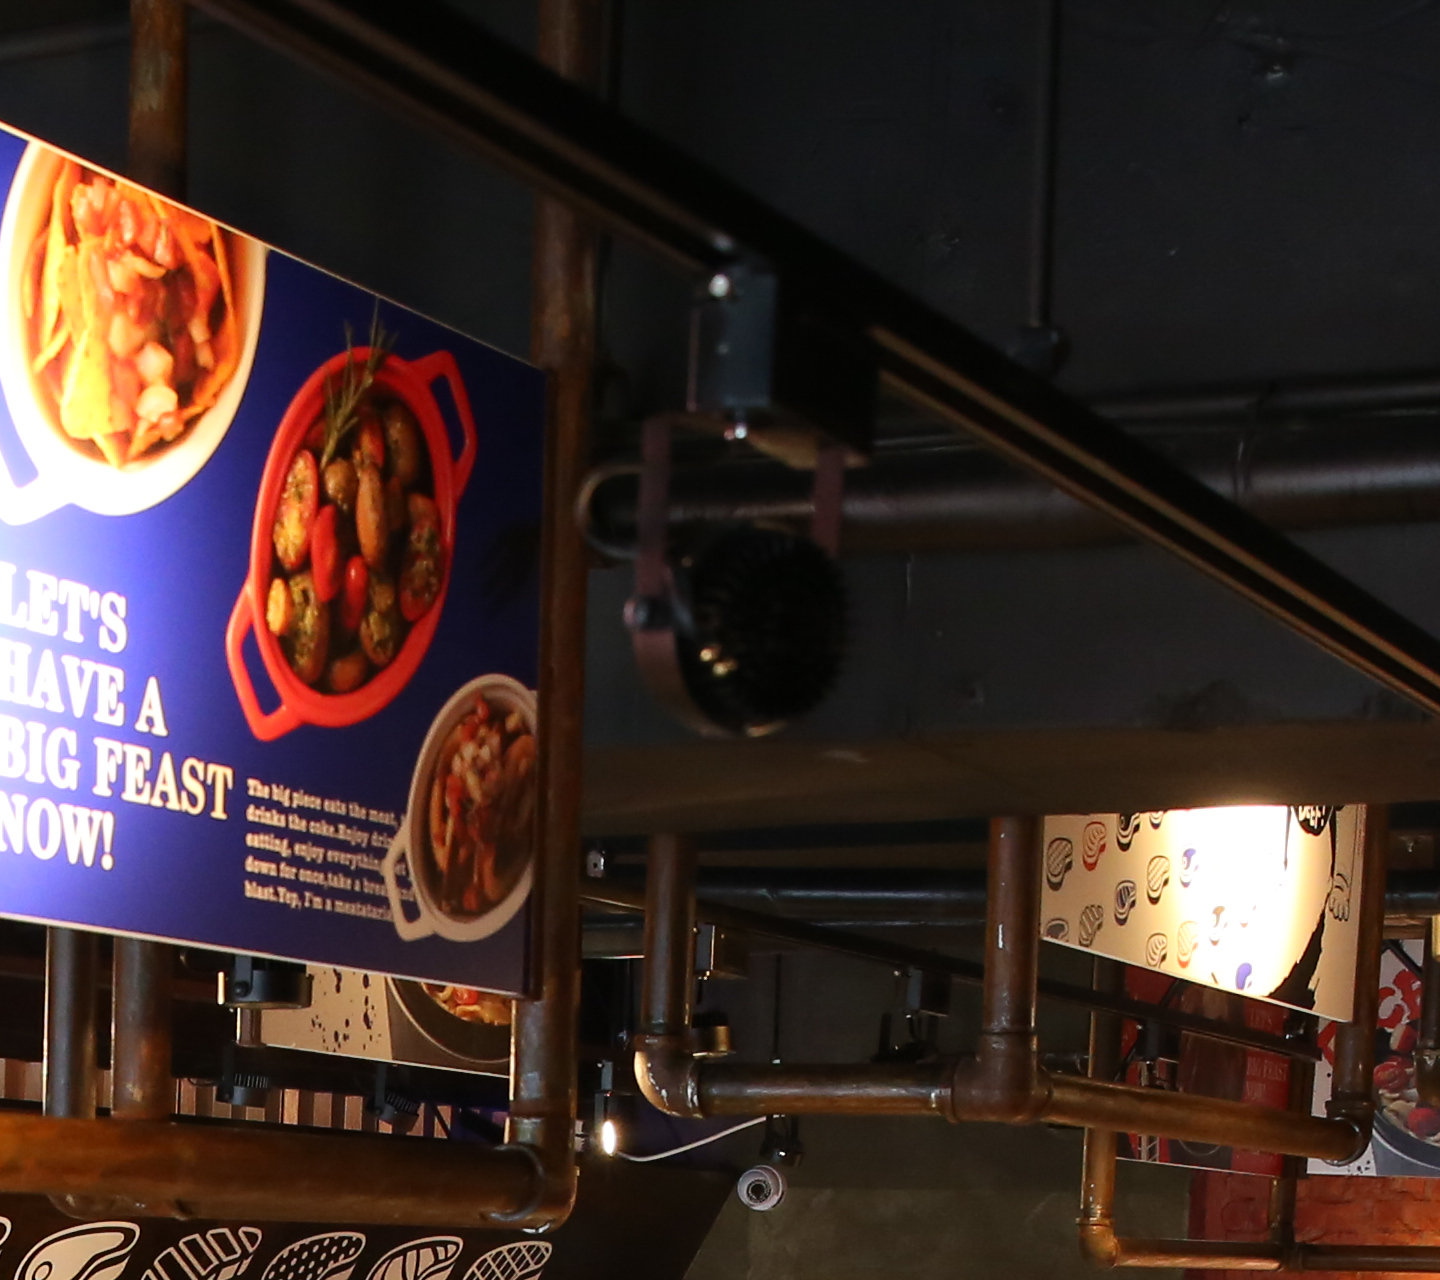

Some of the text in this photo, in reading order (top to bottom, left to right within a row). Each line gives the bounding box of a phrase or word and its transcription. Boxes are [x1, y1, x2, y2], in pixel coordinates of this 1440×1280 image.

[135, 675, 169, 738] A
[93, 736, 234, 821] FEAST
[246, 778, 270, 799] The
[271, 783, 291, 807] big
[292, 789, 321, 810] piece
[348, 802, 367, 820] the
[246, 804, 287, 828] drinks
[288, 813, 307, 832] the
[294, 841, 325, 863] enjoy
[245, 855, 277, 876] down
[279, 861, 298, 880] for
[362, 878, 388, 895] brea
